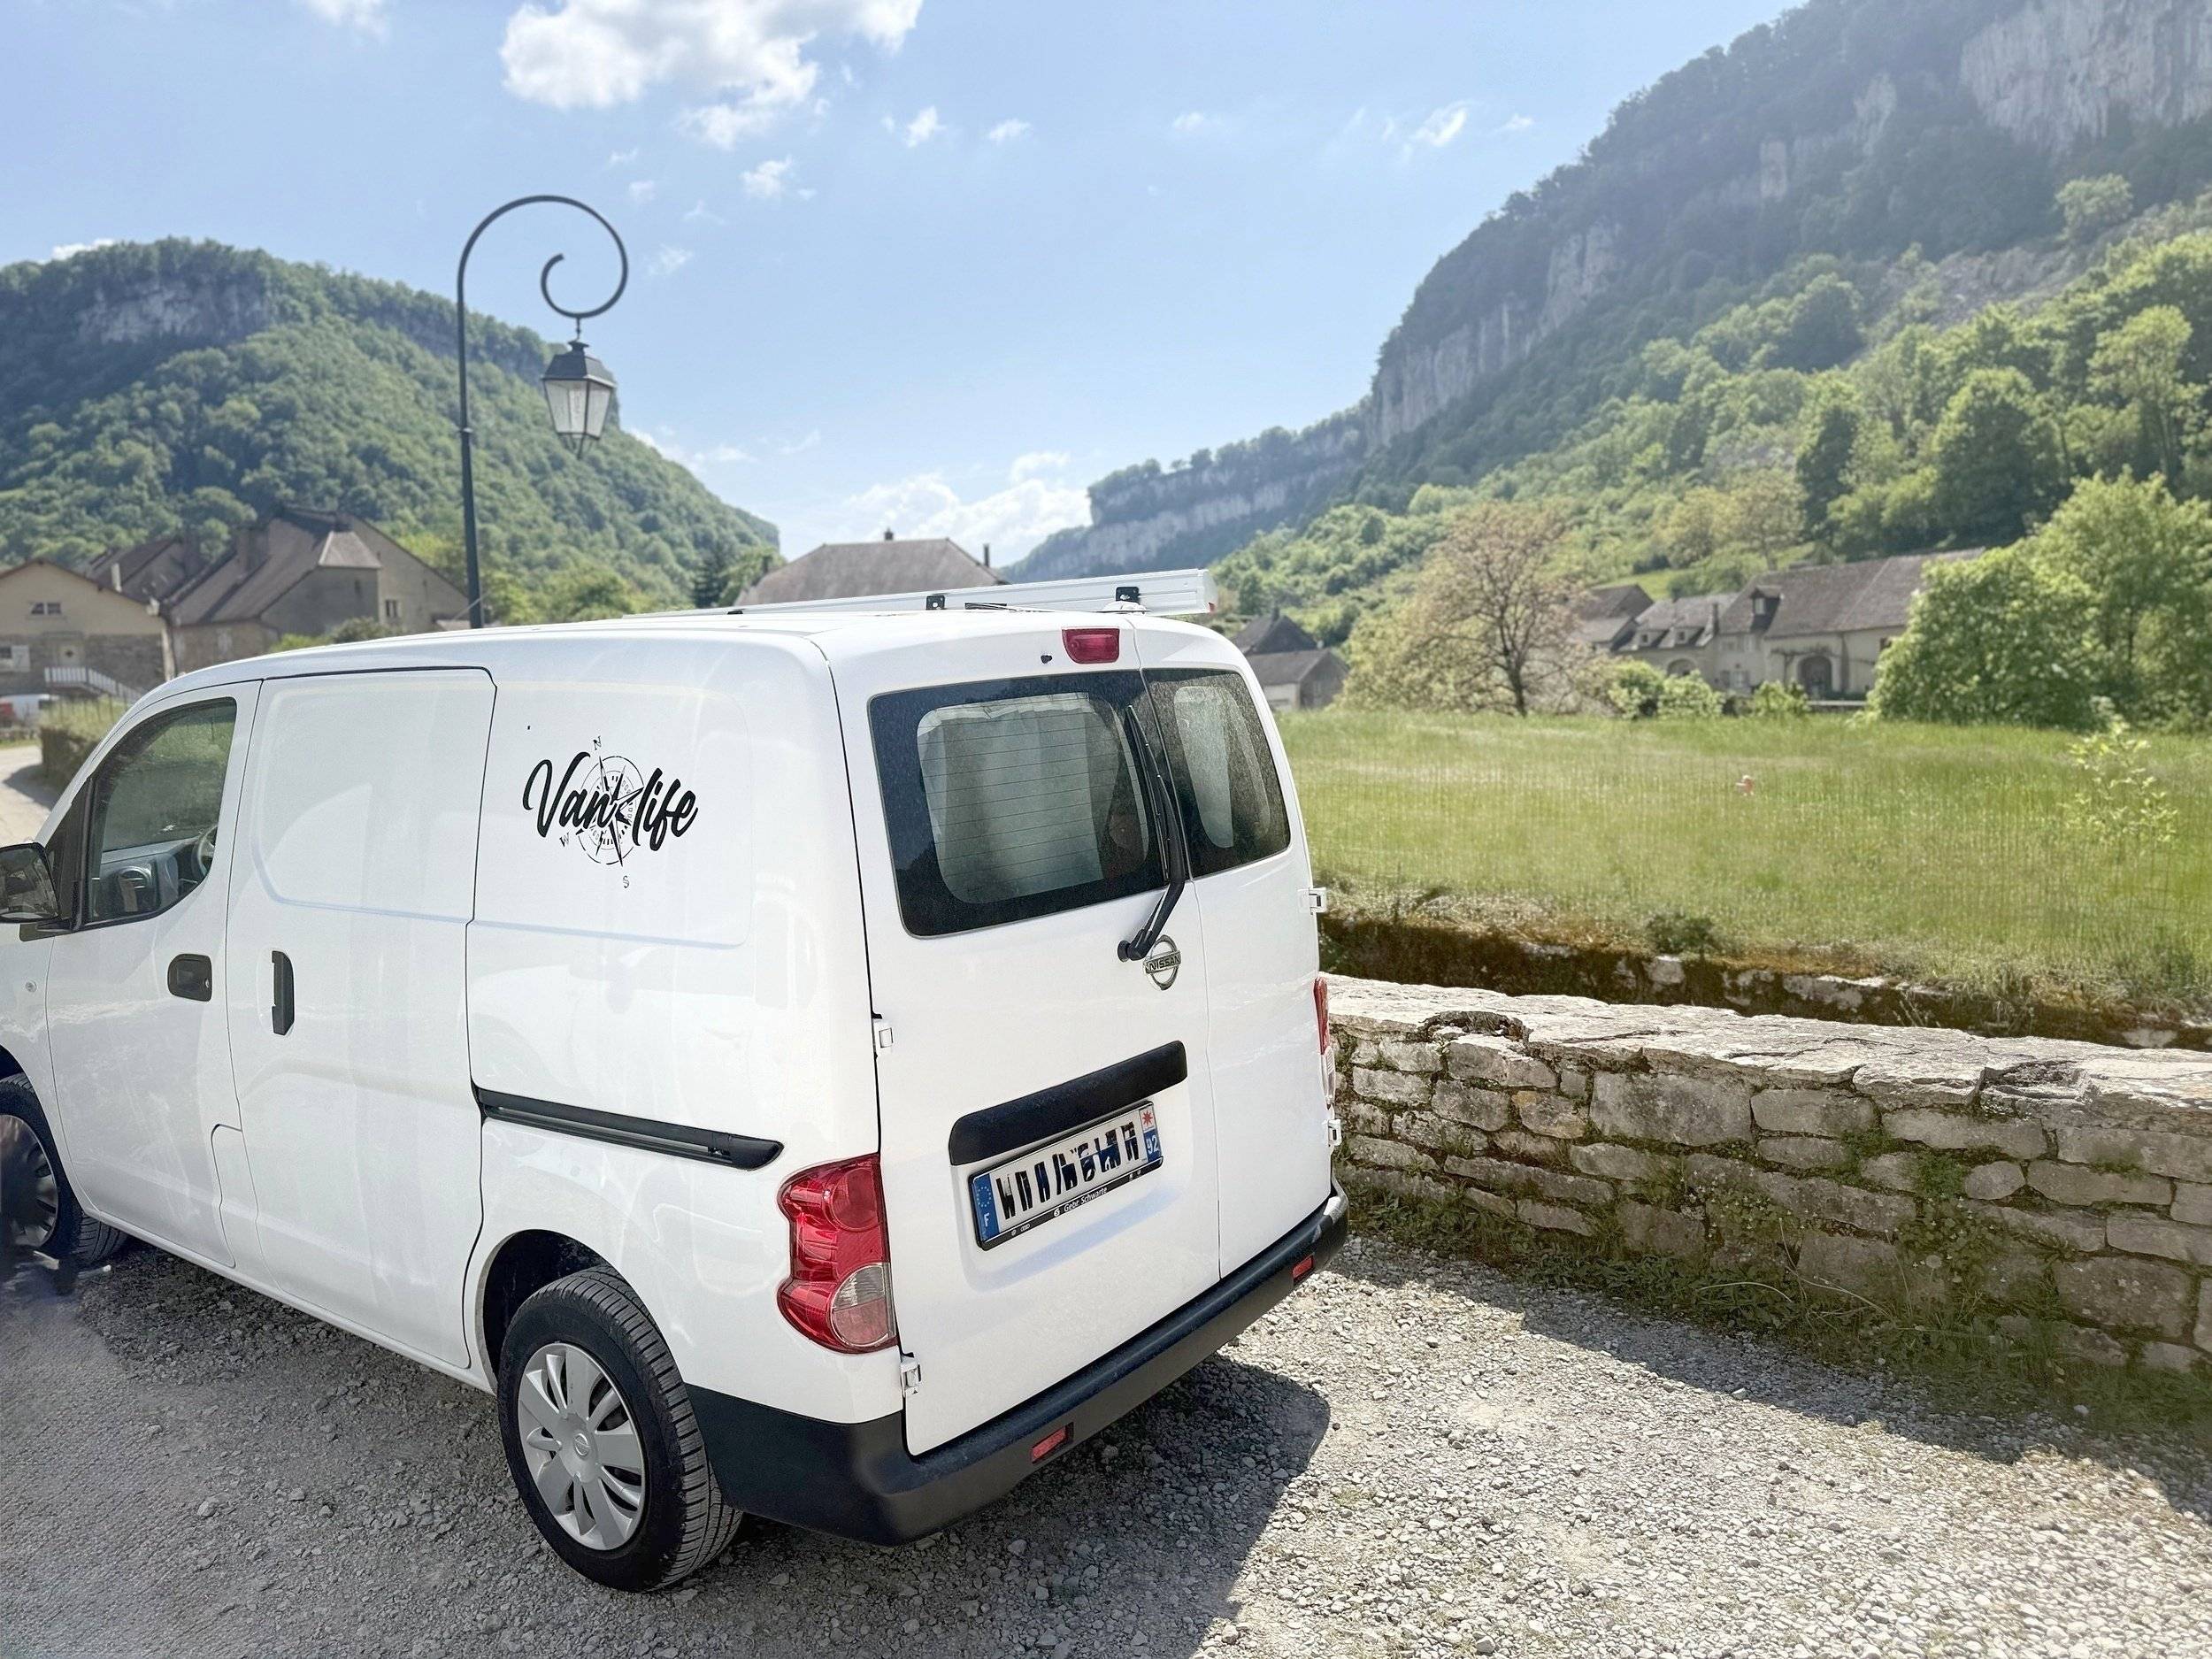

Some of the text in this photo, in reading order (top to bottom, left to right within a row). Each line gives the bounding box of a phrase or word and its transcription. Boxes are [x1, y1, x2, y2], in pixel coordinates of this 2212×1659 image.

[522, 751, 699, 852] Van life
[1145, 954, 1180, 972] NISSAN
[1146, 1134, 1159, 1155] 92
[1064, 1200, 1080, 1213] Gebr.
[982, 1213, 992, 1227] F
